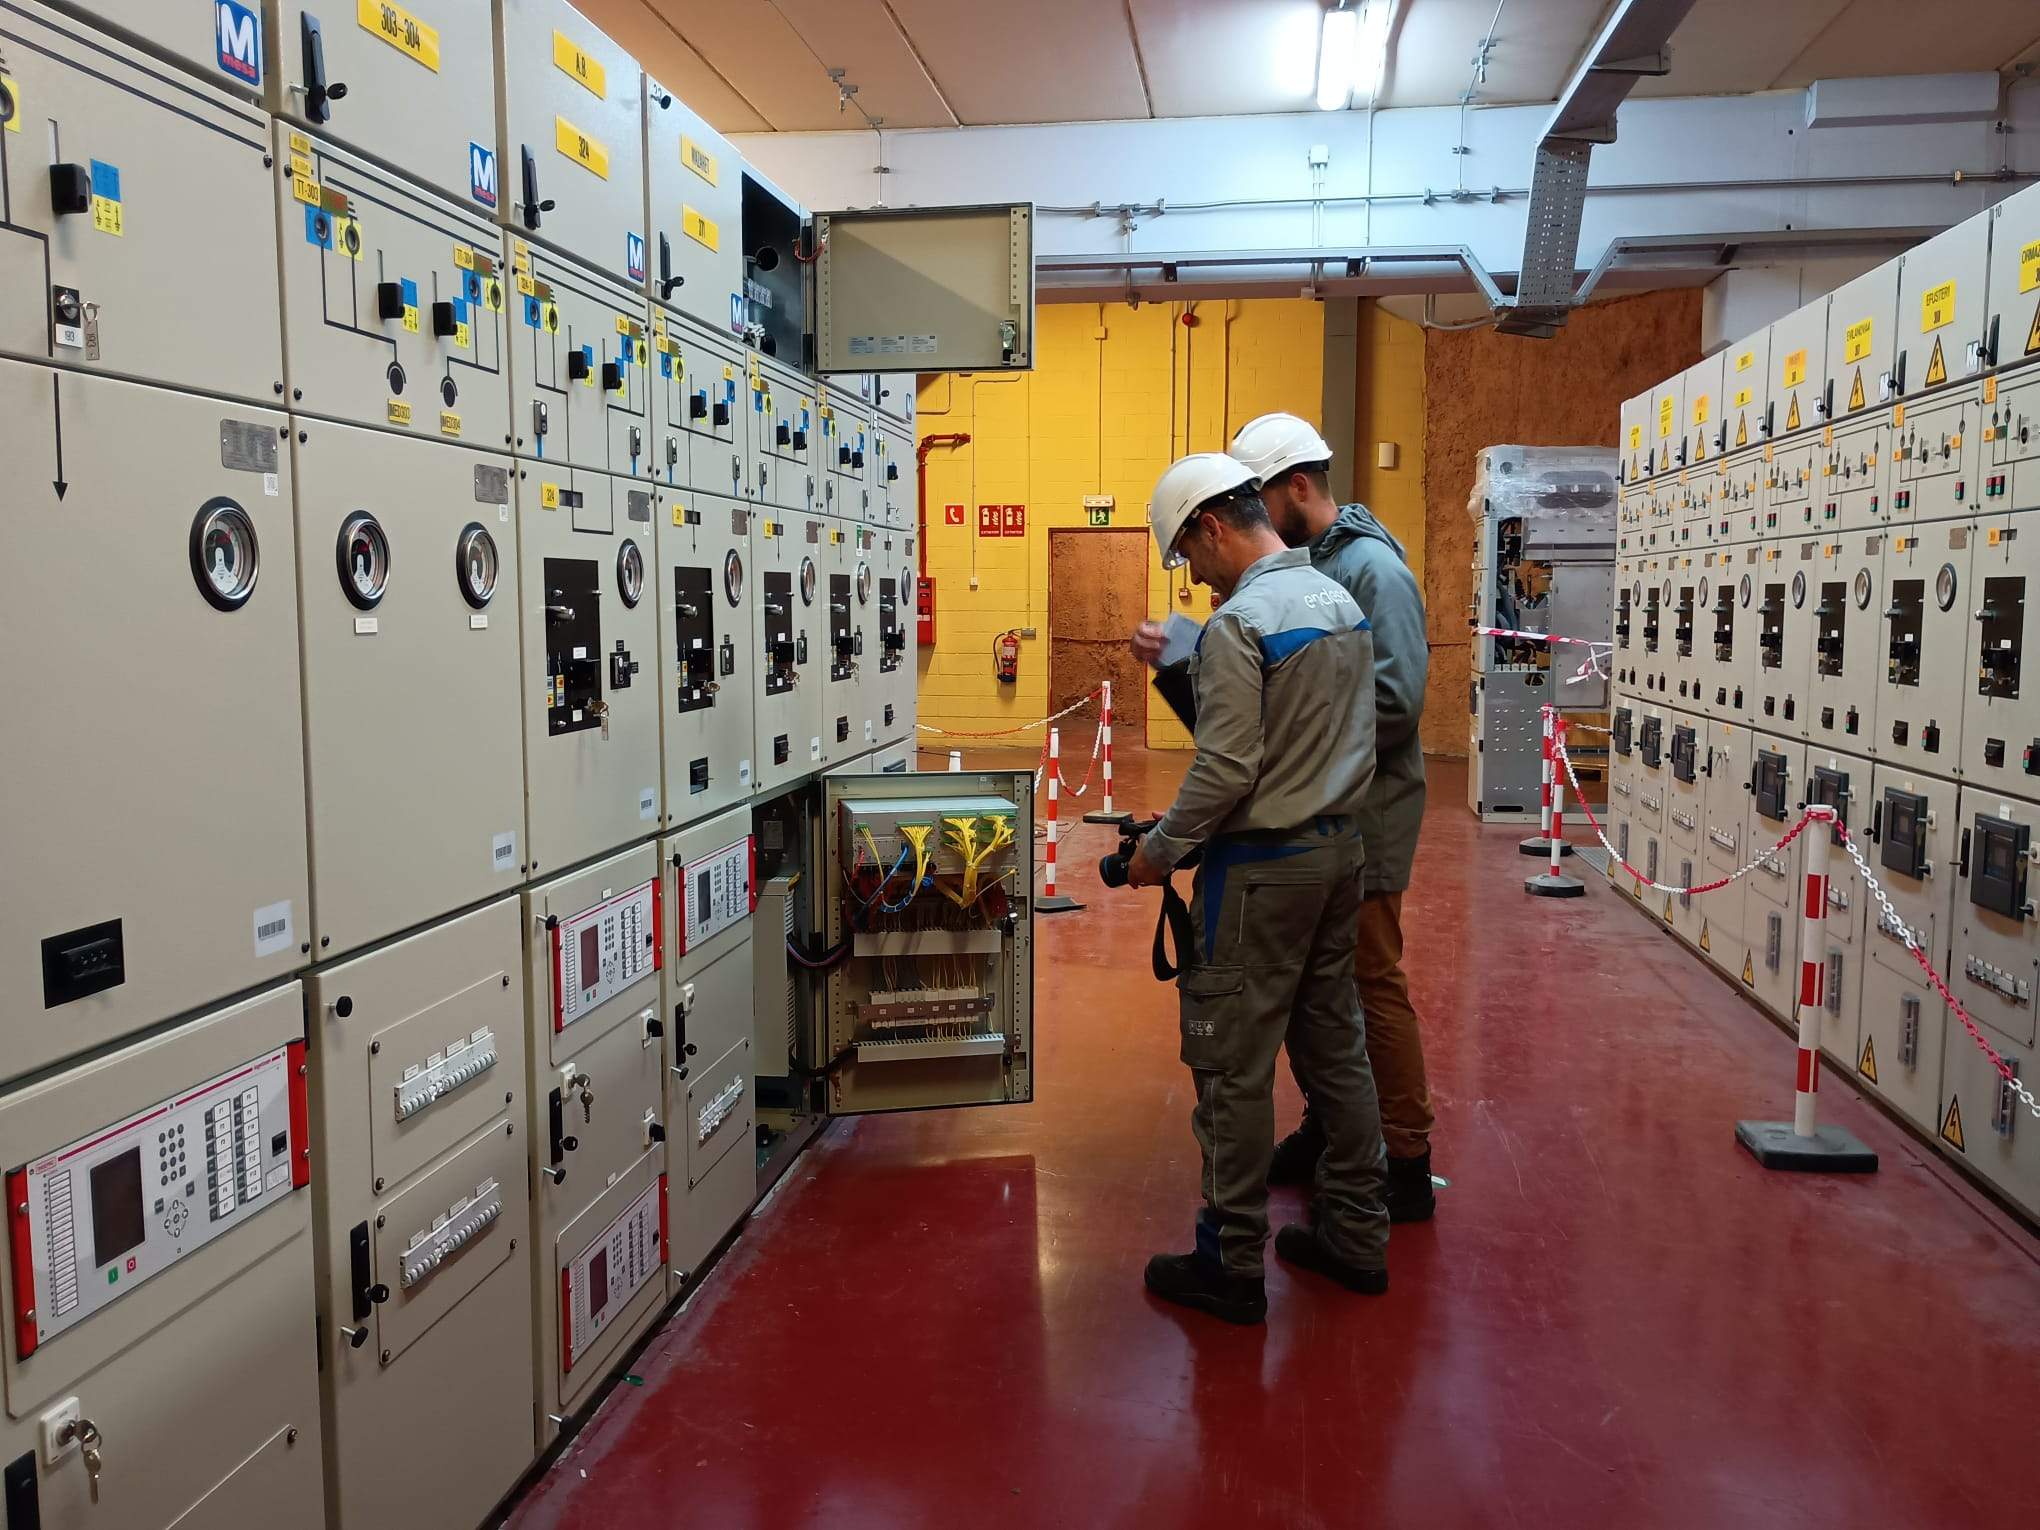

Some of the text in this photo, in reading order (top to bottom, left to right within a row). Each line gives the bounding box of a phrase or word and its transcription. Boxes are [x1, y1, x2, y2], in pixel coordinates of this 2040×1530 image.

[221, 3, 255, 66] M
[381, 2, 420, 52] 303-304
[474, 148, 494, 195] M
